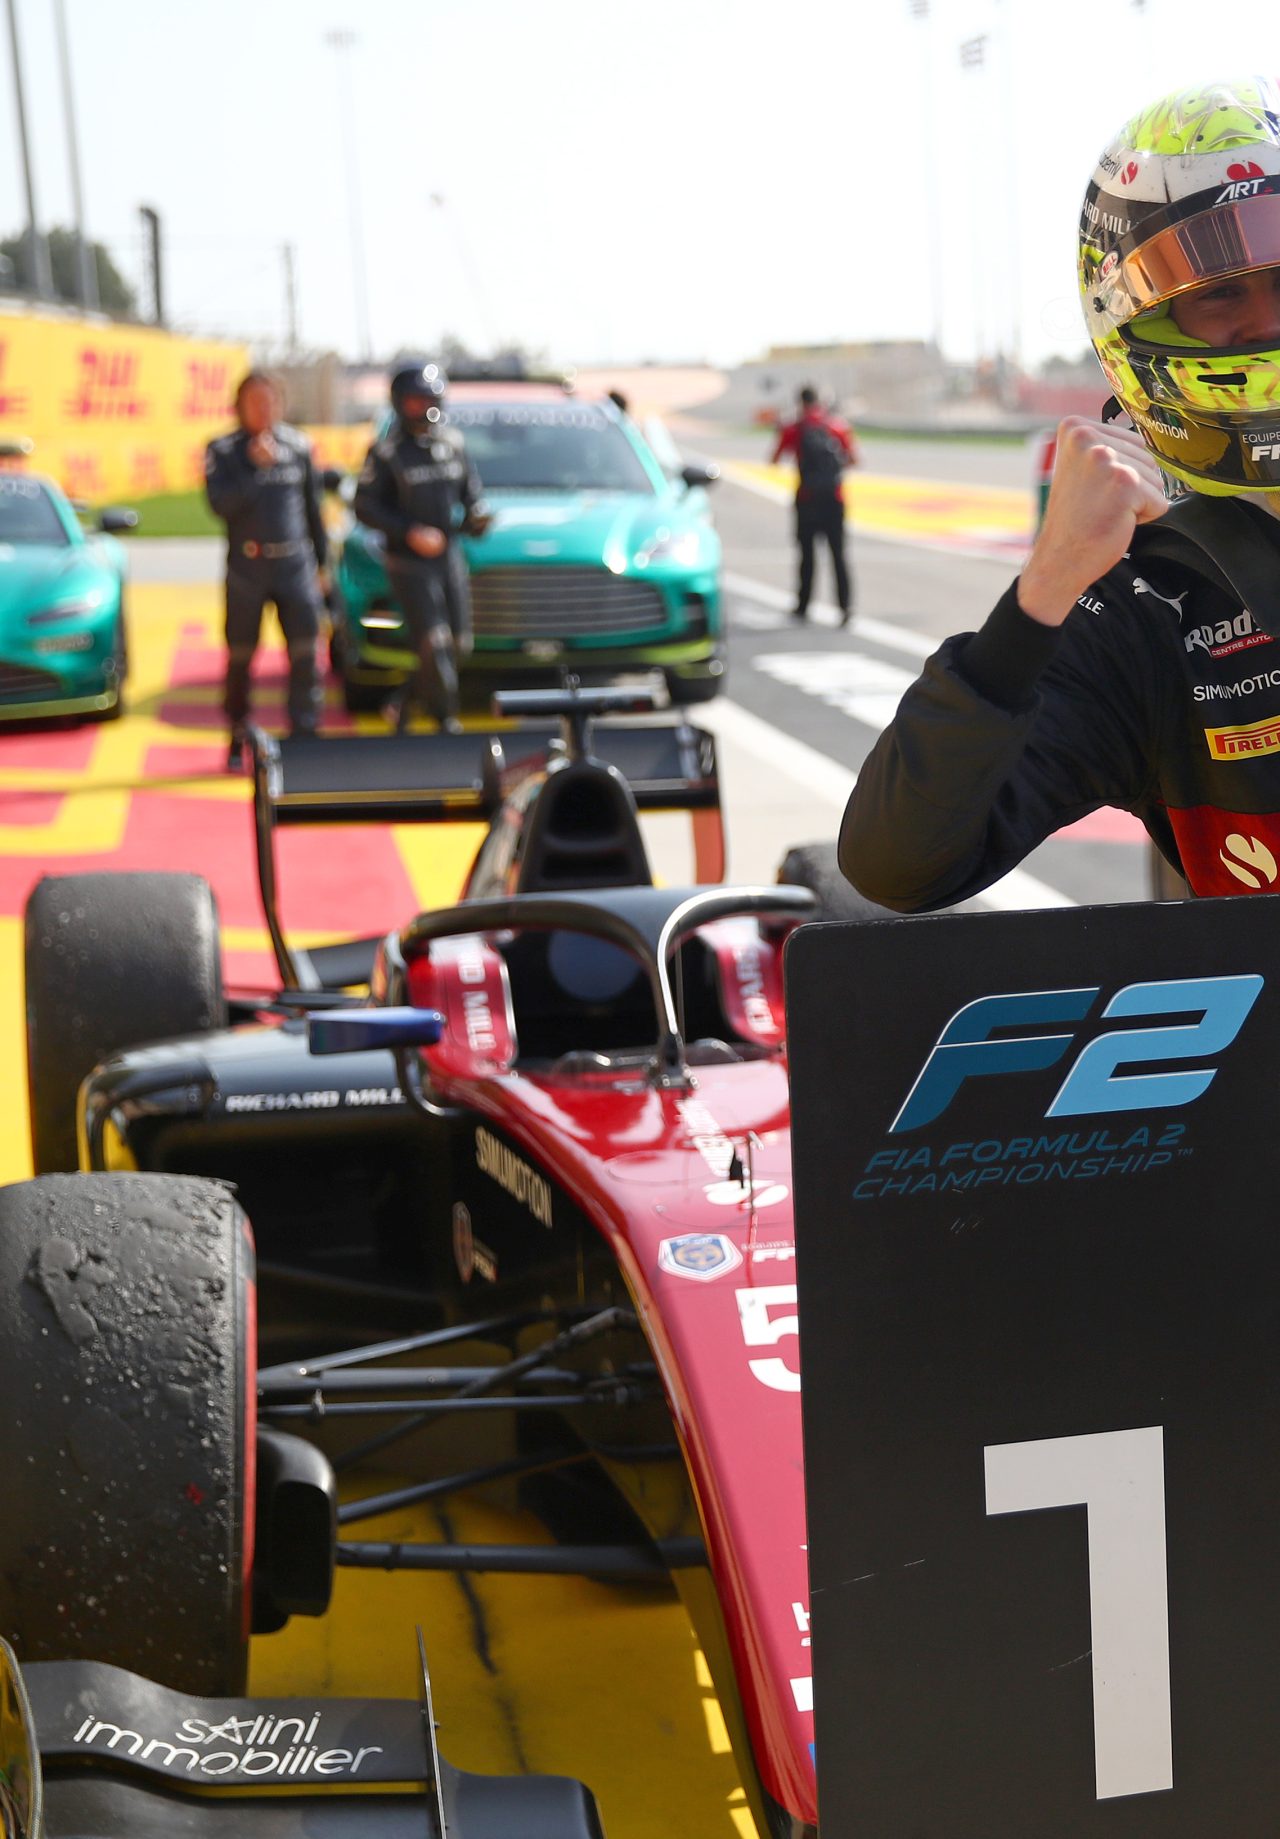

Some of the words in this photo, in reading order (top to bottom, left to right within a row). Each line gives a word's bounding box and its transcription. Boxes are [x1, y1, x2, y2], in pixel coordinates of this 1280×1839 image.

[1214, 178, 1266, 204] ART
[1211, 641, 1244, 656] CENTRE
[888, 973, 1265, 1134] F2
[225, 1090, 340, 1112] RICHARD
[864, 1142, 932, 1174] FIA
[939, 1125, 1152, 1167] FORMULA
[1156, 1124, 1188, 1146] 2
[735, 1284, 801, 1392] 5
[983, 1425, 1173, 1800] 1
[72, 1714, 384, 1776] immobilier
